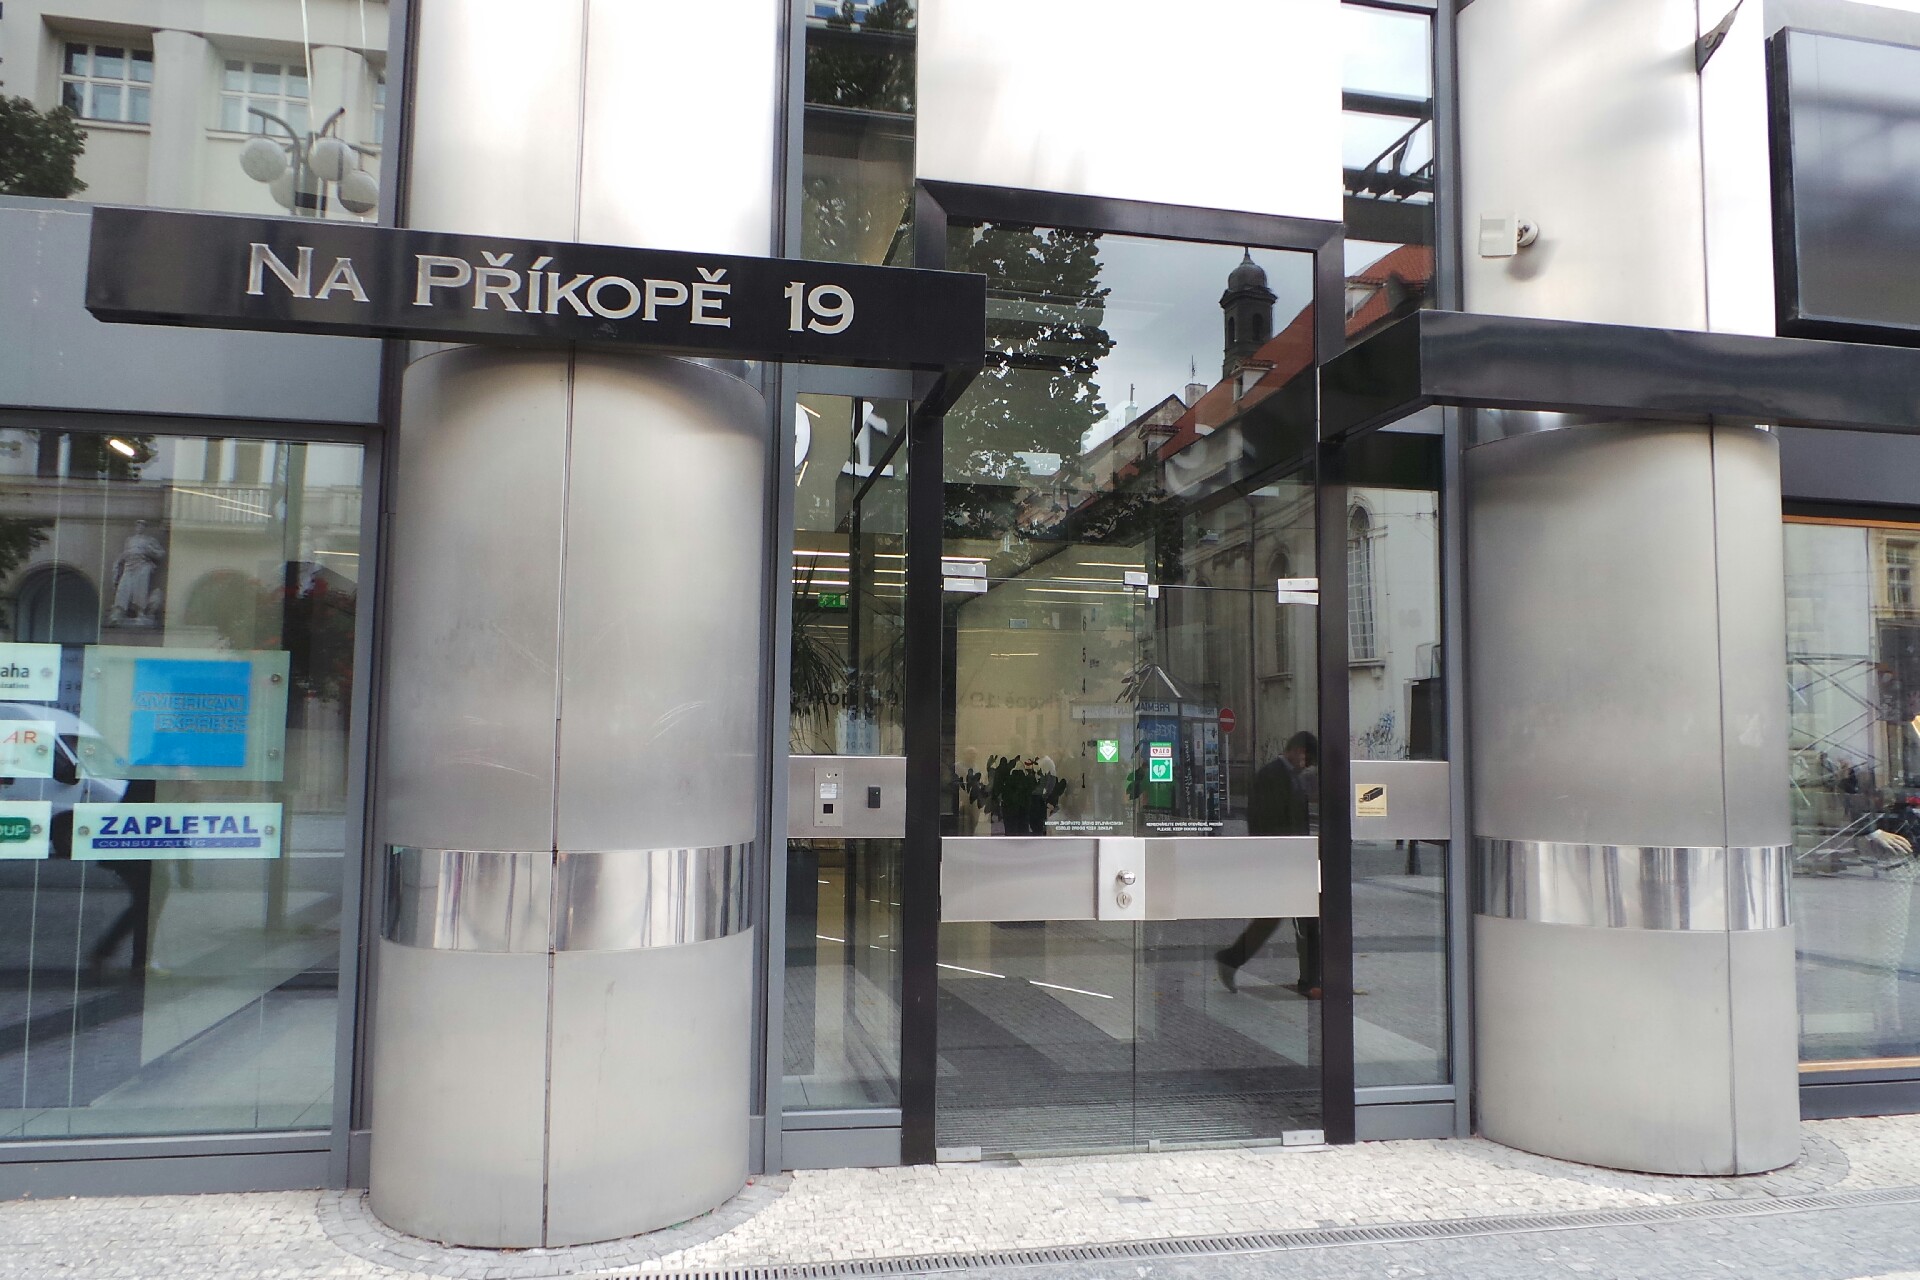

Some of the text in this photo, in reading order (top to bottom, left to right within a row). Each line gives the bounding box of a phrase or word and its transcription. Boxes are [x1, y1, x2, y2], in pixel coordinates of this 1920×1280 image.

[784, 281, 855, 334] 19
[136, 693, 243, 711] AMERICAN
[158, 714, 248, 732] EXPRESS
[0, 730, 37, 744] AR
[100, 815, 259, 835] ZAPLETAL
[98, 838, 206, 848] CONSULTING
